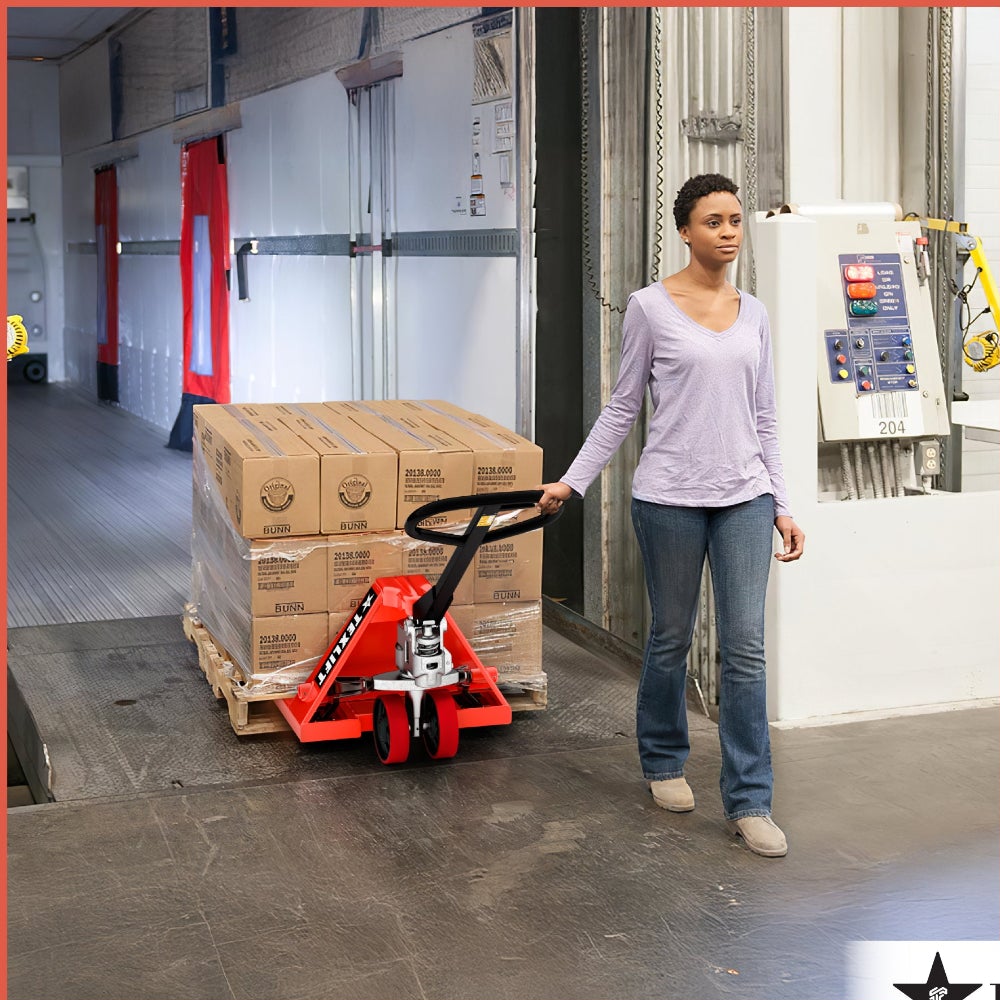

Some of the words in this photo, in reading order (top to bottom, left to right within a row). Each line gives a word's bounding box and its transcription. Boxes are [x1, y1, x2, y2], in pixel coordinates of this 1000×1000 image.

[879, 421, 906, 435] 204
[263, 525, 291, 535] BUNN
[340, 521, 368, 531] BUNN
[493, 590, 521, 600] BUNN
[275, 602, 305, 613] BUNN
[317, 613, 363, 686] TEXLIFT
